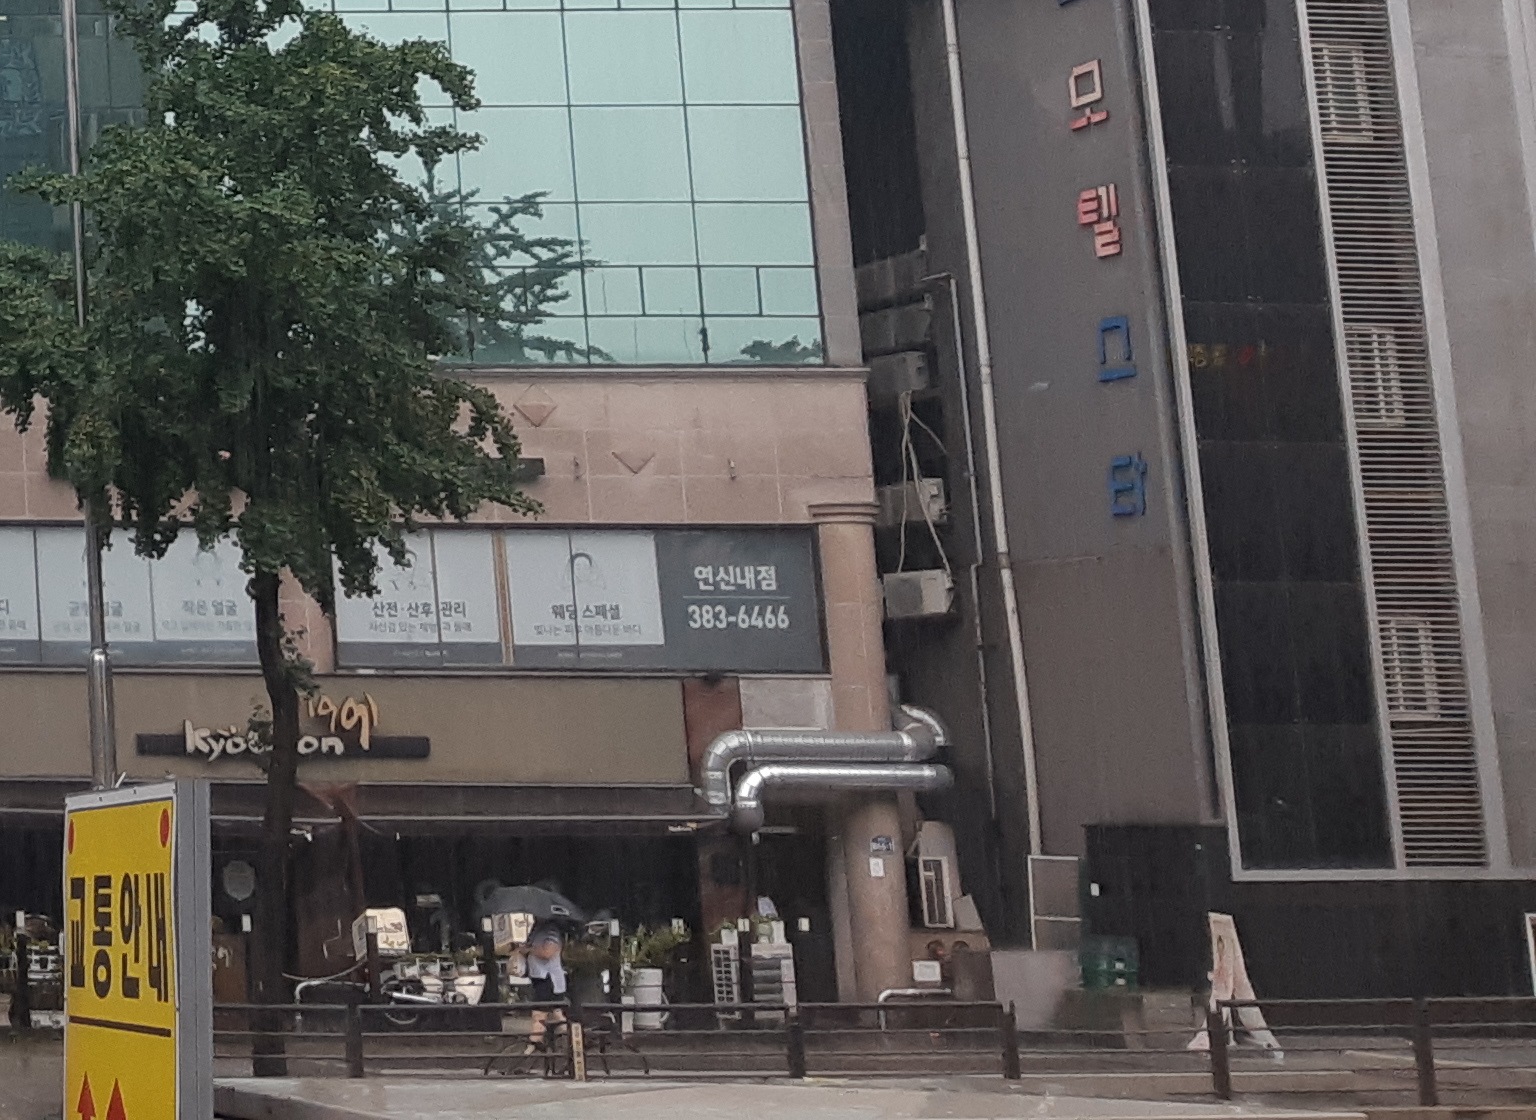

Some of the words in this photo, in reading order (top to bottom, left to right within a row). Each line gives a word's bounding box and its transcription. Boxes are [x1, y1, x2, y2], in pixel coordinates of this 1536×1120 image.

[693, 565, 778, 591] 연신내점
[440, 601, 467, 619] 관리
[687, 604, 790, 630] 383-6466
[70, 871, 170, 1004] 교통안내
